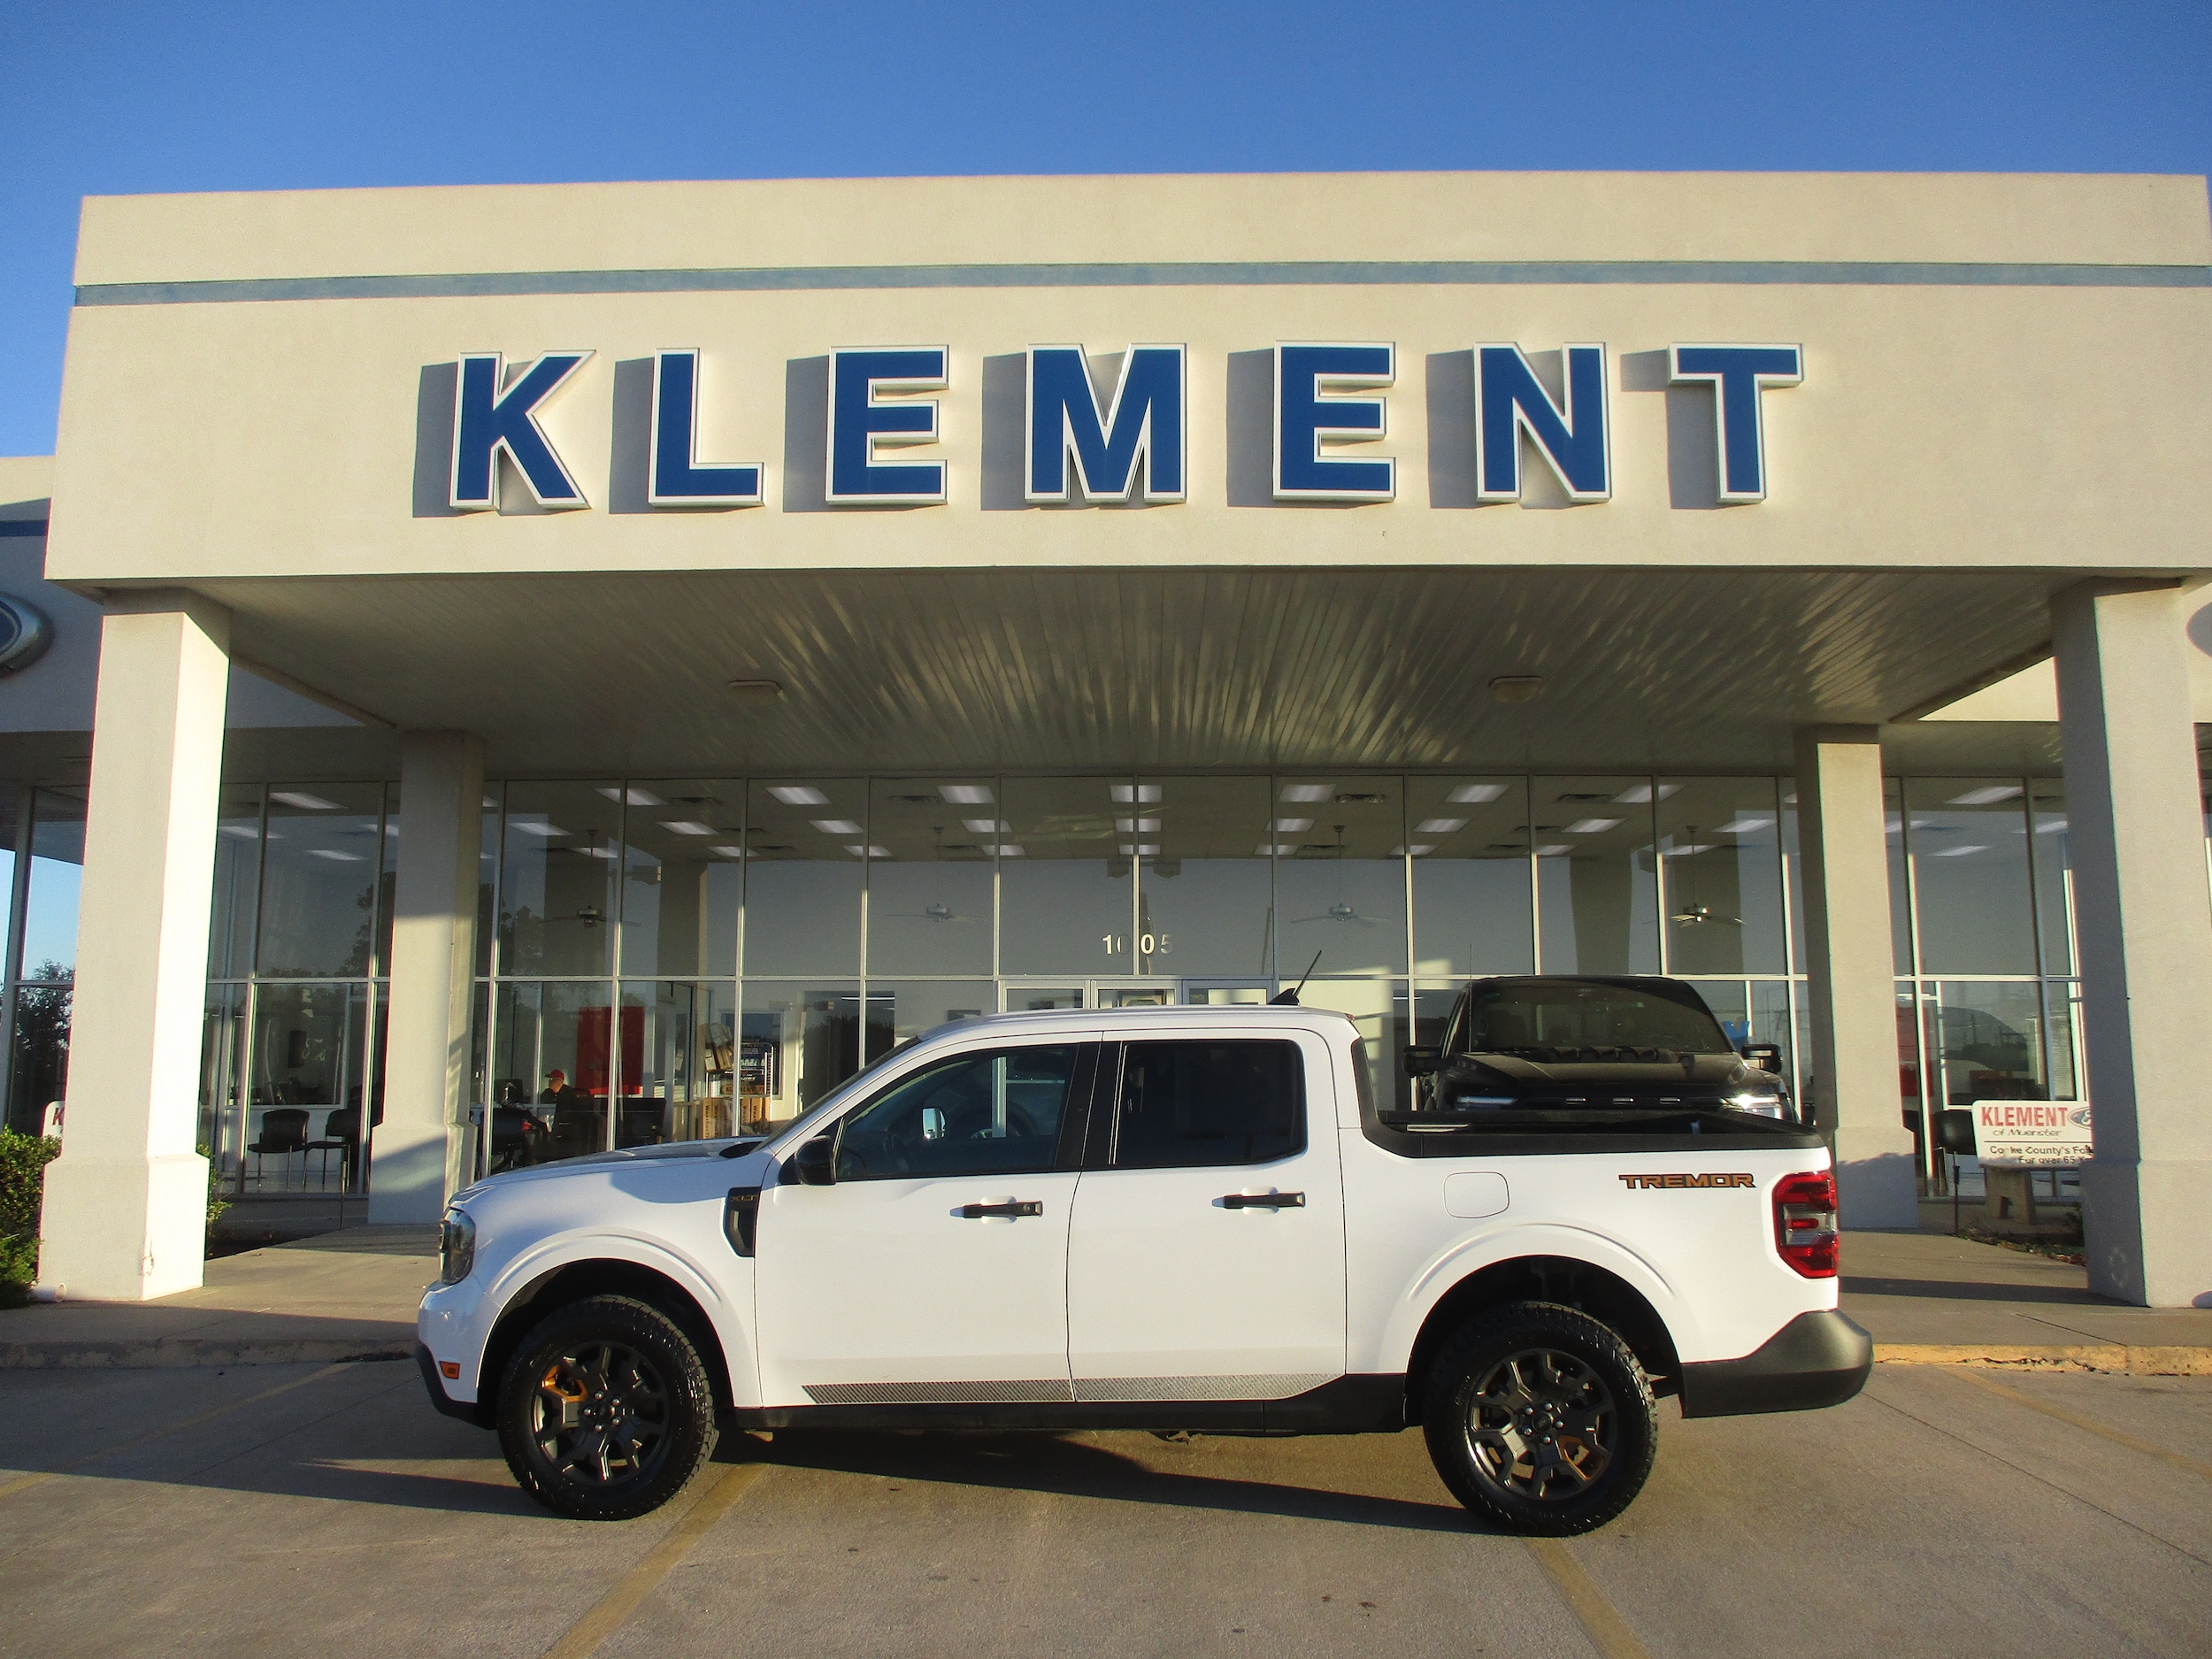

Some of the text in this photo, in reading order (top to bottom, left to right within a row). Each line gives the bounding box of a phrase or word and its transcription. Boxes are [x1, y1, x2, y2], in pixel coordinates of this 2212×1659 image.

[449, 342, 1804, 511] KLEMENT
[1981, 1106, 2068, 1127] KLEMENT
[1989, 1145, 2023, 1154] Coke
[2025, 1146, 2070, 1156] County's
[1618, 1173, 1756, 1189] TREMOR
